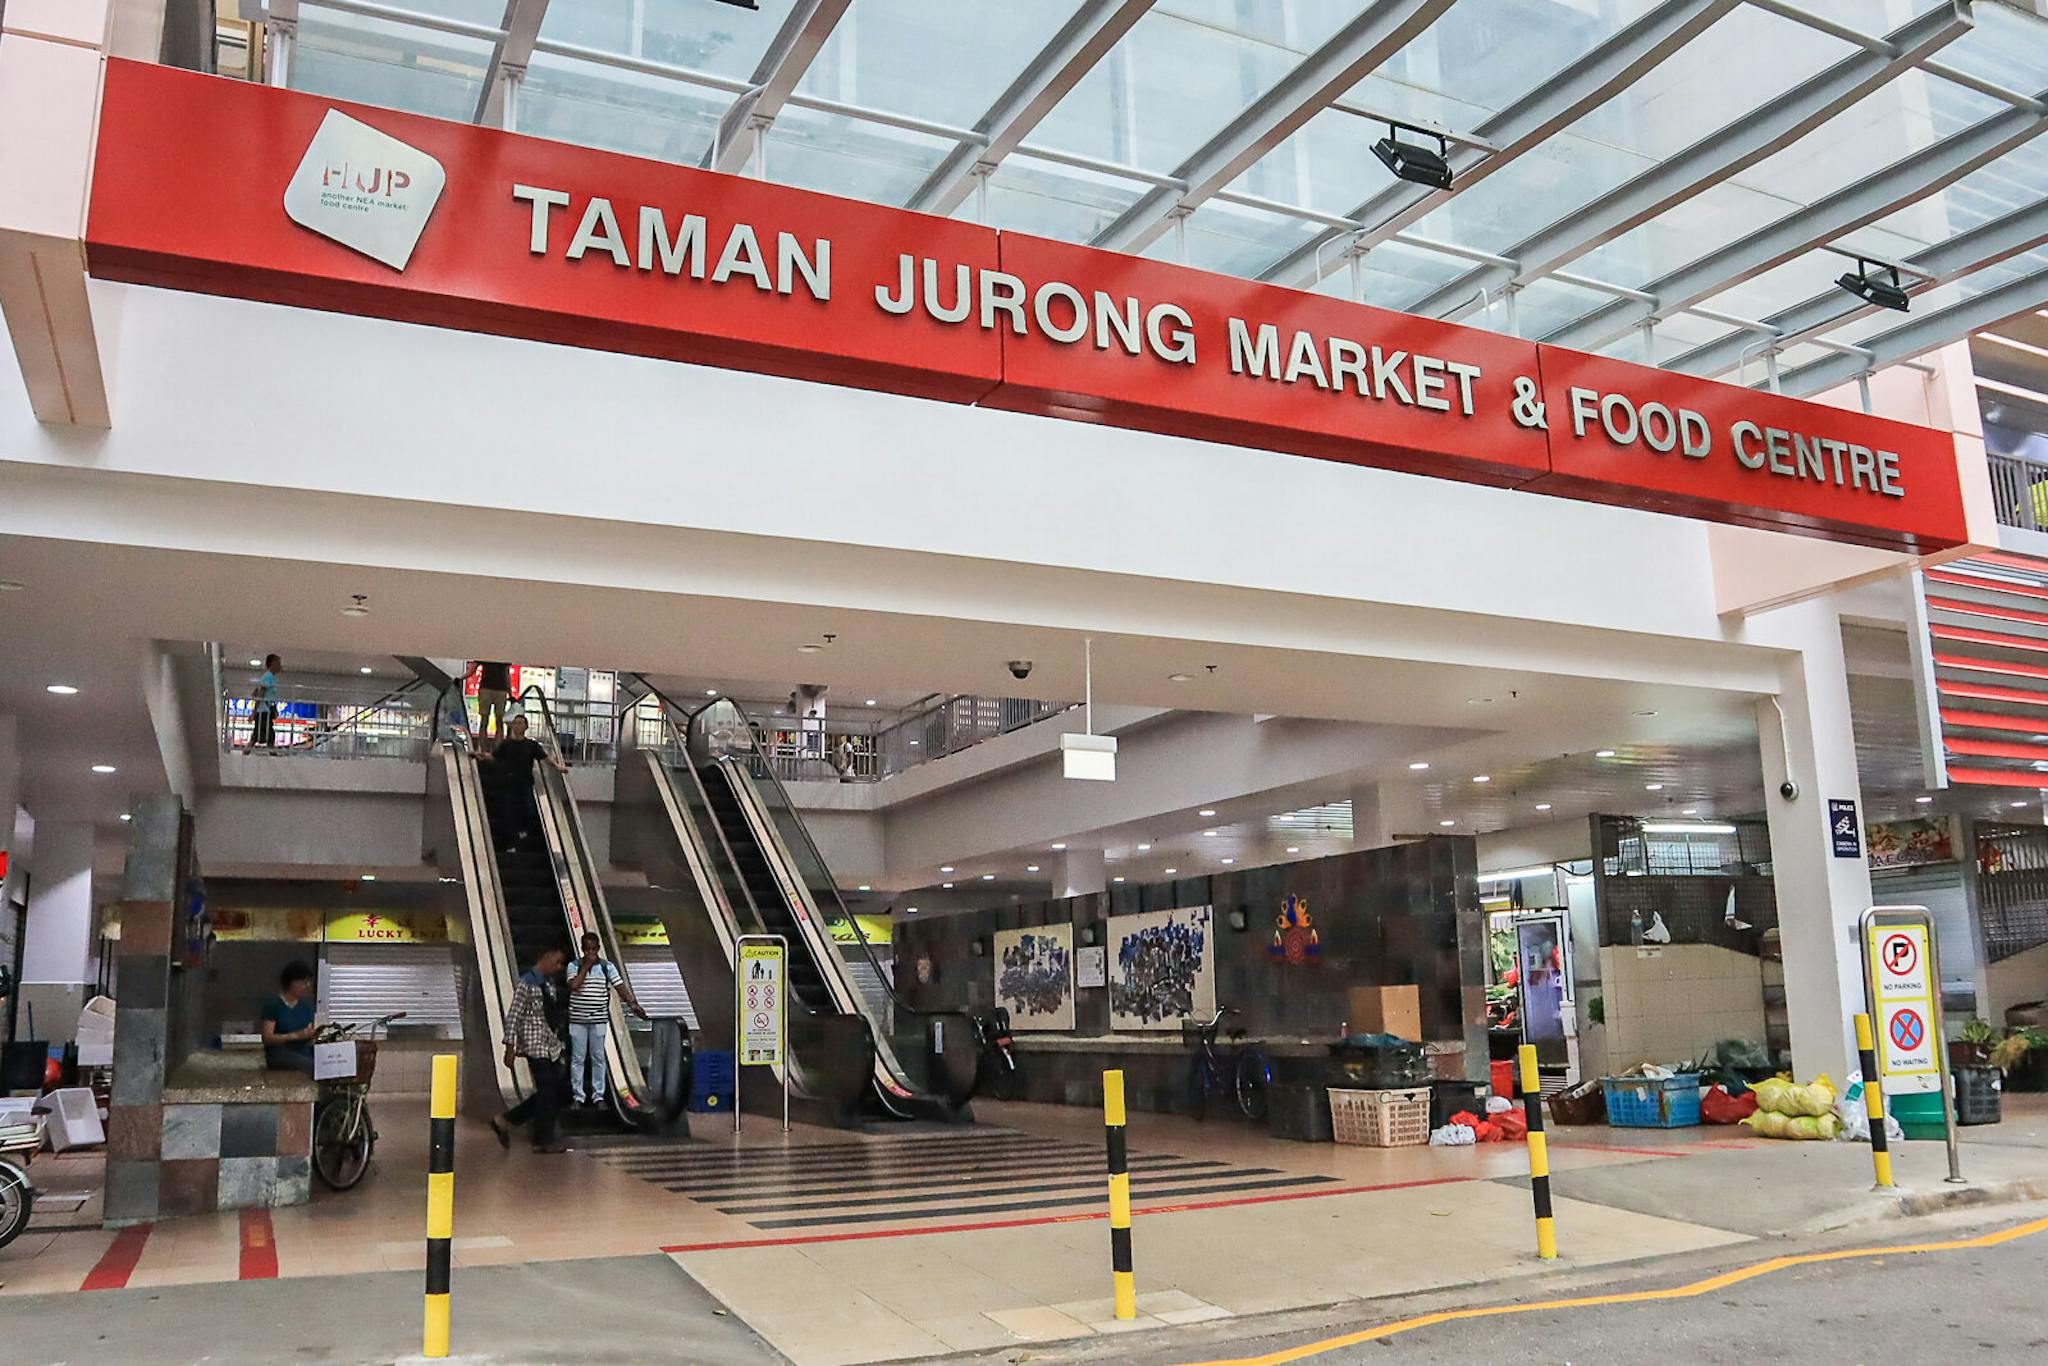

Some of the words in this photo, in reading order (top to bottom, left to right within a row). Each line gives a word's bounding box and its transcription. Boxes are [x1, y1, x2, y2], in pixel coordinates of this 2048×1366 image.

[321, 192, 354, 203] another
[356, 196, 375, 206] NEA
[320, 199, 340, 208] food
[342, 202, 370, 213] centre
[513, 183, 832, 302] TAMAN
[874, 254, 1197, 365] JURONG
[1228, 316, 1481, 417] MARKET
[1512, 376, 1549, 430] &
[1568, 386, 1712, 459] FOOD
[1731, 420, 1905, 498] CENTRE
[358, 930, 404, 938] LUCKY
[1895, 982, 1922, 990] PARKING
[1903, 1057, 1928, 1066] WAITING
